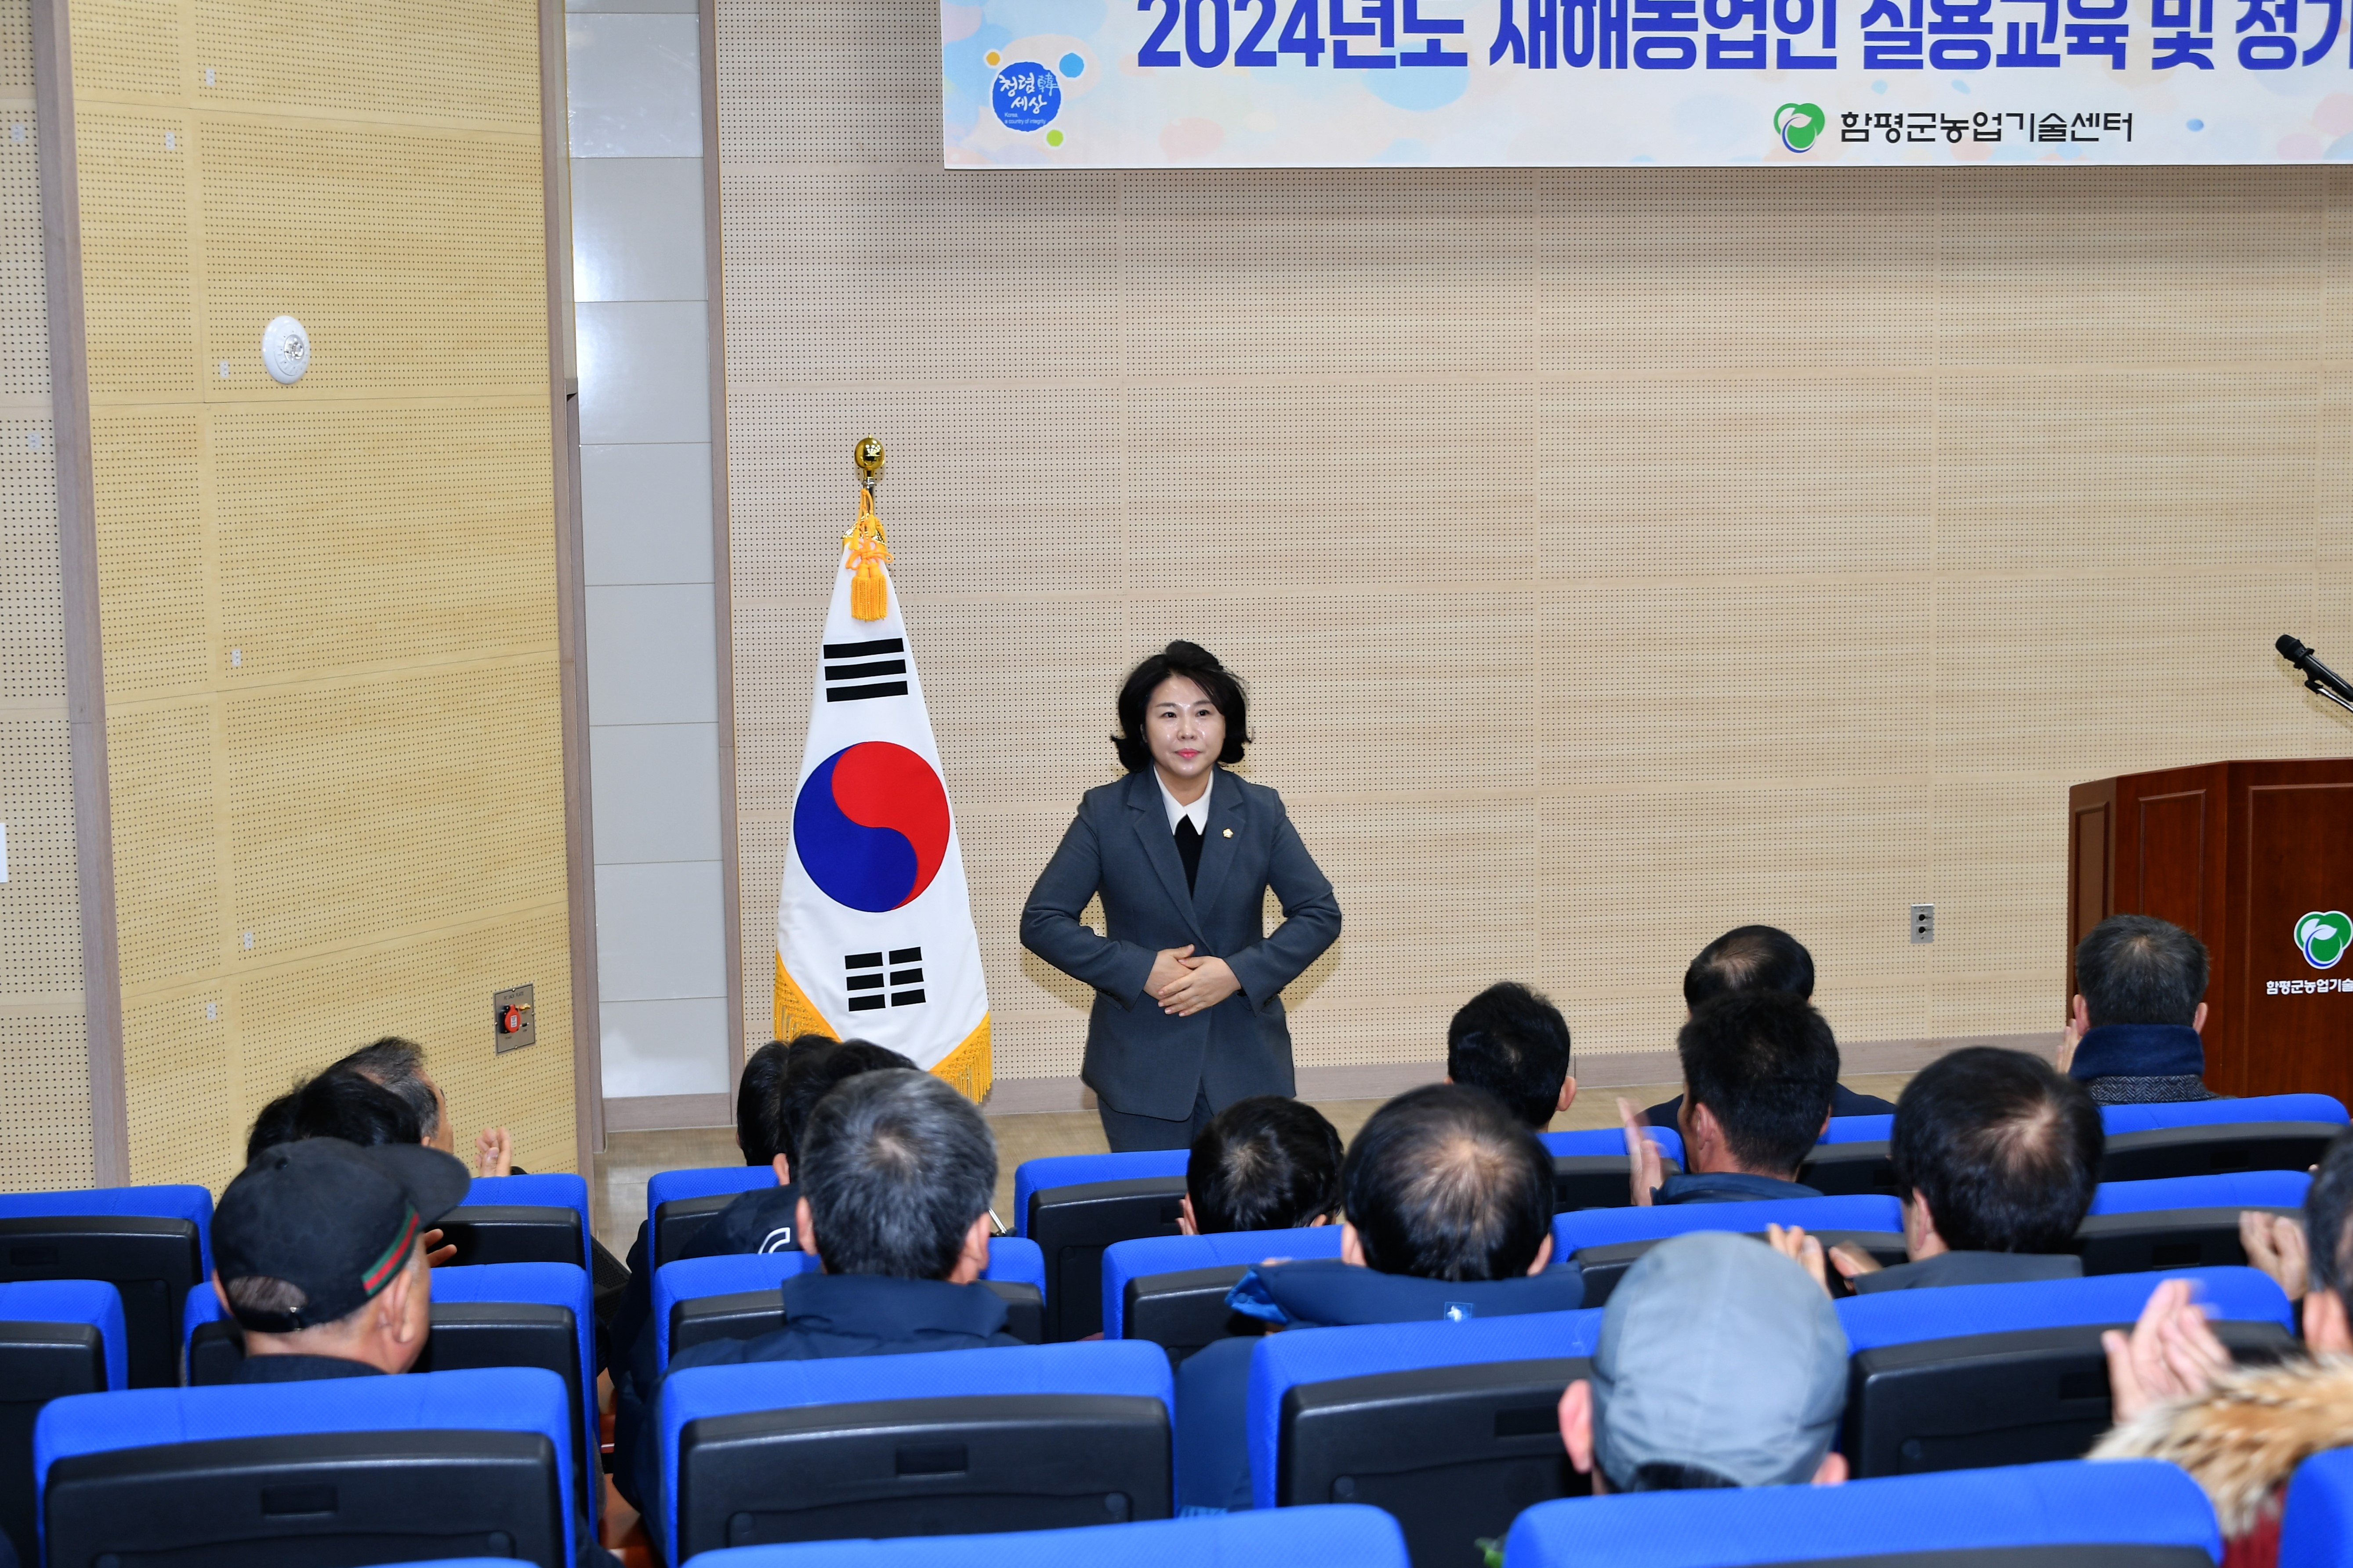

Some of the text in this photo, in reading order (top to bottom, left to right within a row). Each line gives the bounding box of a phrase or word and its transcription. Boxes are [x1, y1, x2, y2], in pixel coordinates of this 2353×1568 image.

[1136, 0, 1468, 69] 2024년도
[1489, 0, 1837, 69] 새해농업인
[1860, 0, 2129, 70] 실용교육
[2151, 0, 2215, 70] 및
[1011, 94, 1047, 114] 세상
[1840, 111, 2133, 144] 함평군농업기술센터
